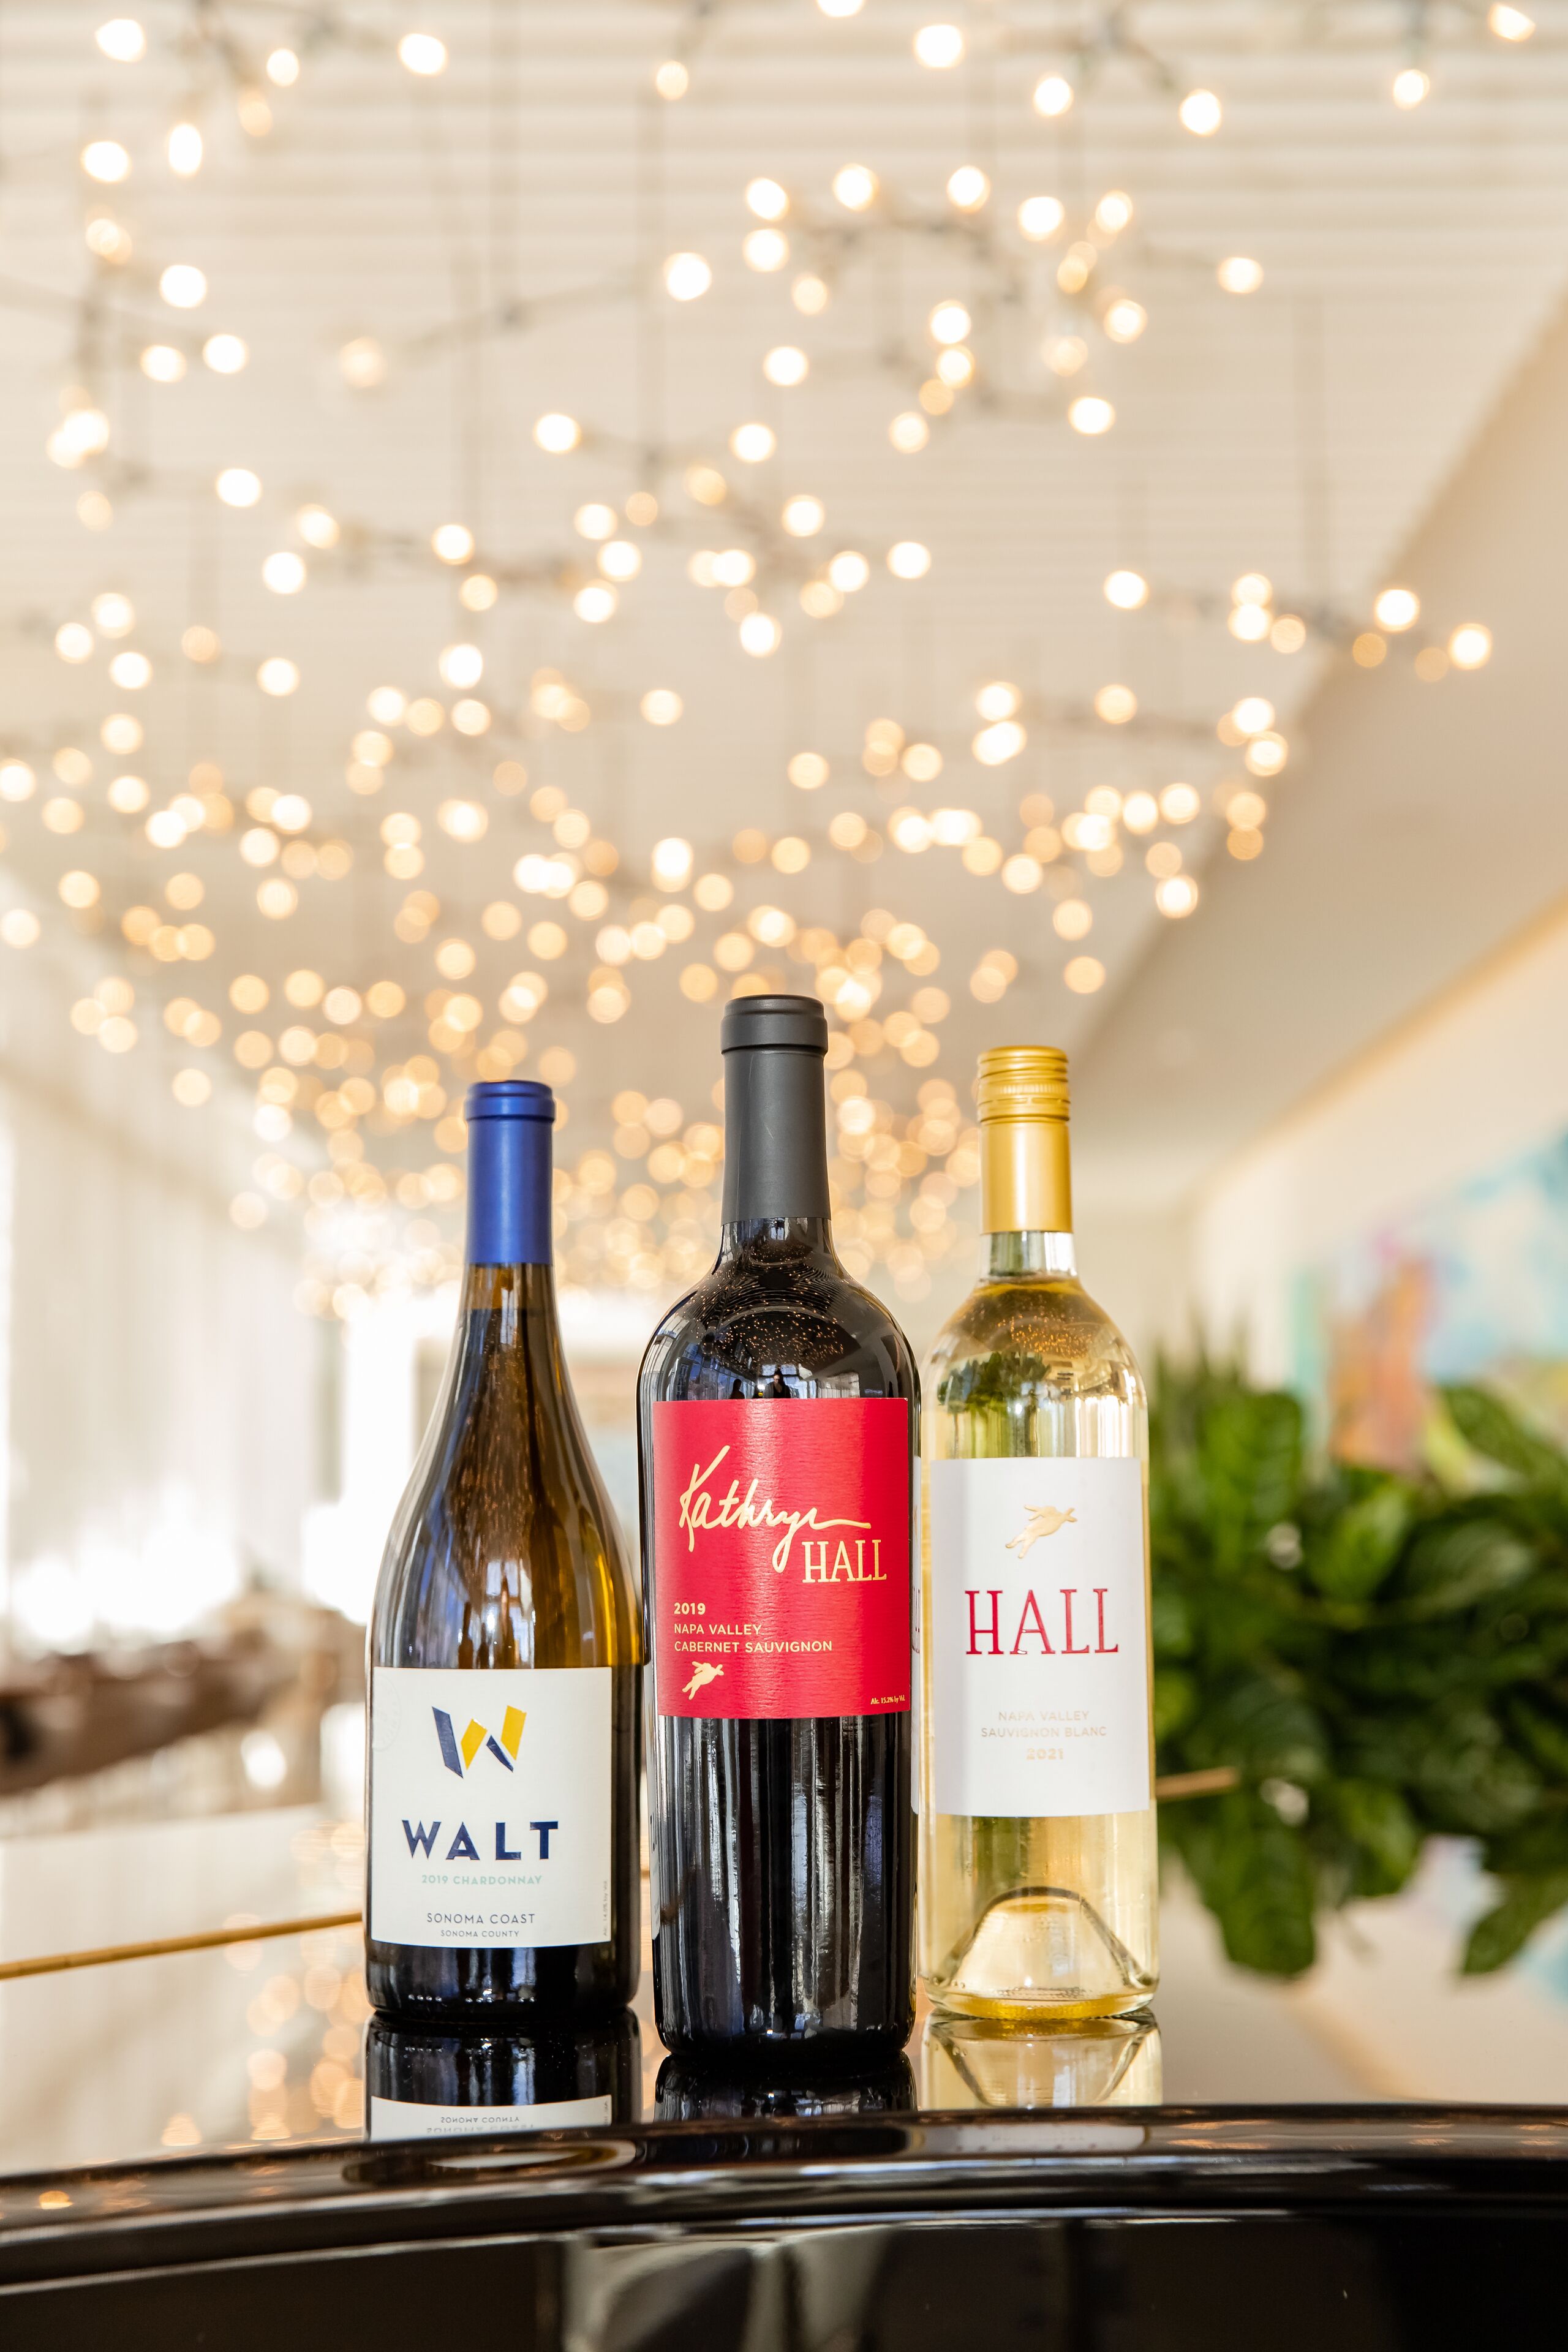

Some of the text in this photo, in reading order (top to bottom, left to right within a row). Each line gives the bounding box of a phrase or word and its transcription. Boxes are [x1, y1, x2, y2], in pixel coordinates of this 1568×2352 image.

[678, 1444, 872, 1574] Kathryn
[801, 1539, 887, 1583] HALL
[674, 1602, 706, 1615] 2019
[964, 1588, 1119, 1656] HALL
[674, 1624, 762, 1635] NAPA VALLEY
[674, 1640, 832, 1653] CABERNET SAUVIGNON
[894, 1695, 899, 1704] by
[998, 1710, 1089, 1721] NAPA VALLEY
[981, 1726, 1107, 1738] SAUVIGNON BLANC
[1026, 1747, 1064, 1760] 2021
[401, 1819, 559, 1861] WALT
[423, 1874, 543, 1885] 2019 CHARDONNAY
[427, 1912, 535, 1924] SONOMA COAST
